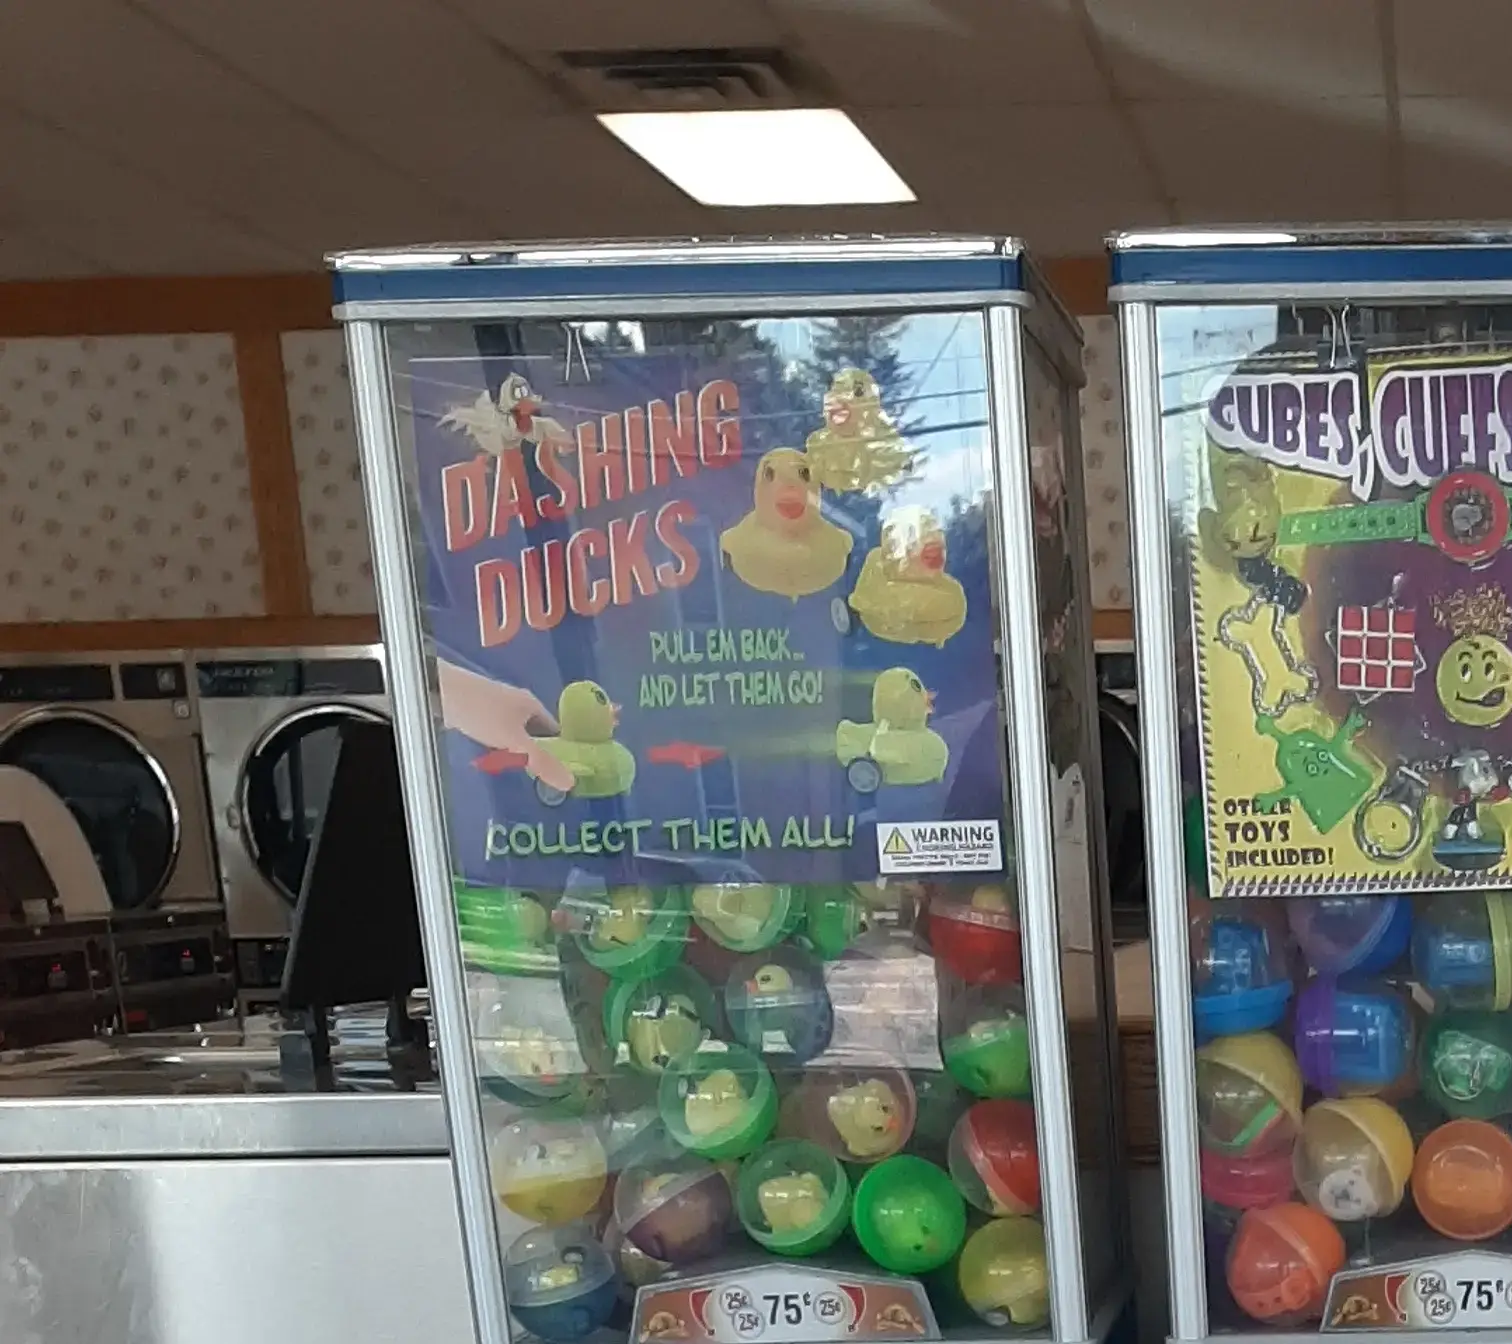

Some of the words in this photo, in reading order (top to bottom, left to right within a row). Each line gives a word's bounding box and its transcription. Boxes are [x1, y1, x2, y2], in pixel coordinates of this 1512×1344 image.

[440, 379, 744, 553] DASHING
[473, 500, 702, 648] DUCKS
[649, 627, 704, 665] PULL
[639, 672, 677, 709] AND
[682, 671, 721, 707] LET
[725, 670, 785, 707] THEM
[787, 669, 824, 705] GO!
[485, 817, 653, 860] COLLECT
[662, 816, 772, 850] THEM
[780, 814, 854, 849] ALL!
[911, 825, 995, 843] WARNING
[1224, 821, 1291, 844] TOYS
[1227, 847, 1334, 868] INCLUDED!
[762, 1291, 812, 1326] 75¢
